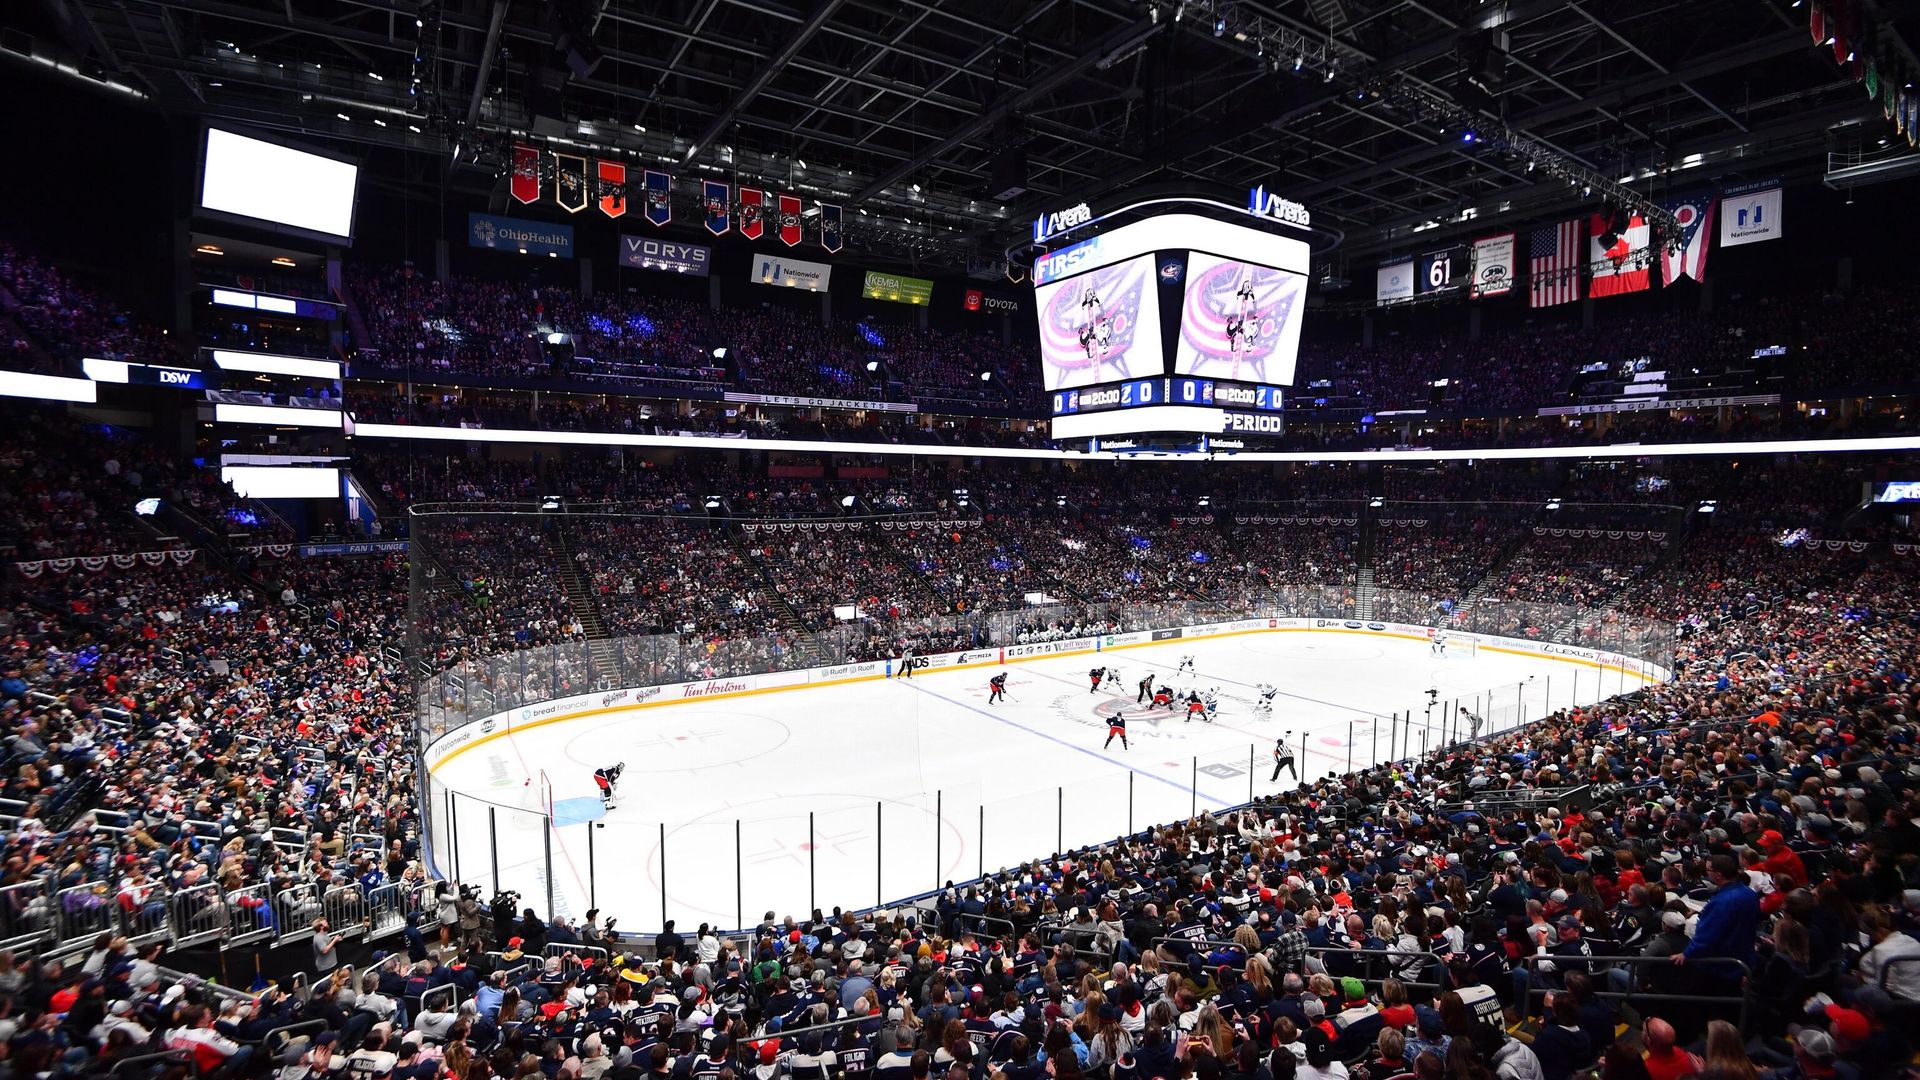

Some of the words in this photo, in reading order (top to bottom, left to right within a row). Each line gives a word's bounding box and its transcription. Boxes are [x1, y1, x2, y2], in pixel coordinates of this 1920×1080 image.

[1265, 193, 1310, 225] Arena
[1046, 206, 1092, 236] Arena
[500, 228, 568, 246] OhioHealth
[1731, 227, 1770, 238] Nationwide
[626, 238, 705, 262] VORYS
[783, 267, 820, 279] Nationwide
[1429, 258, 1451, 287] 61
[872, 275, 899, 289] KEMBA
[984, 297, 1018, 311] TOYOTA
[160, 371, 191, 384] DSW
[1054, 394, 1063, 412] 0
[1091, 389, 1120, 405] 20:00
[1140, 382, 1152, 402] 0
[1183, 381, 1195, 401] 0
[1227, 388, 1255, 404] 20:00
[1272, 389, 1282, 408] 0
[765, 395, 800, 404] LET'S
[830, 399, 885, 410] JACKETS
[1579, 403, 1618, 413] LET'S
[1627, 402, 1645, 410] GO
[1653, 398, 1728, 410] JACKETS
[1223, 412, 1281, 433] PERIOD
[1208, 438, 1244, 449] Nationwide
[349, 545, 368, 553] FAN
[1555, 647, 1594, 659] LEXUS
[910, 657, 929, 669] ADS
[1594, 652, 1611, 665] Tim
[1611, 654, 1640, 672] Hortons
[830, 667, 848, 676] Ruoff
[857, 664, 875, 673] Ruoff
[683, 684, 703, 698] Tim
[705, 681, 746, 695] Hortons
[533, 706, 556, 717] bread
[557, 699, 589, 712] financial
[440, 731, 471, 752] Nationwide
[844, 1051, 866, 1063] FOLIGNO
